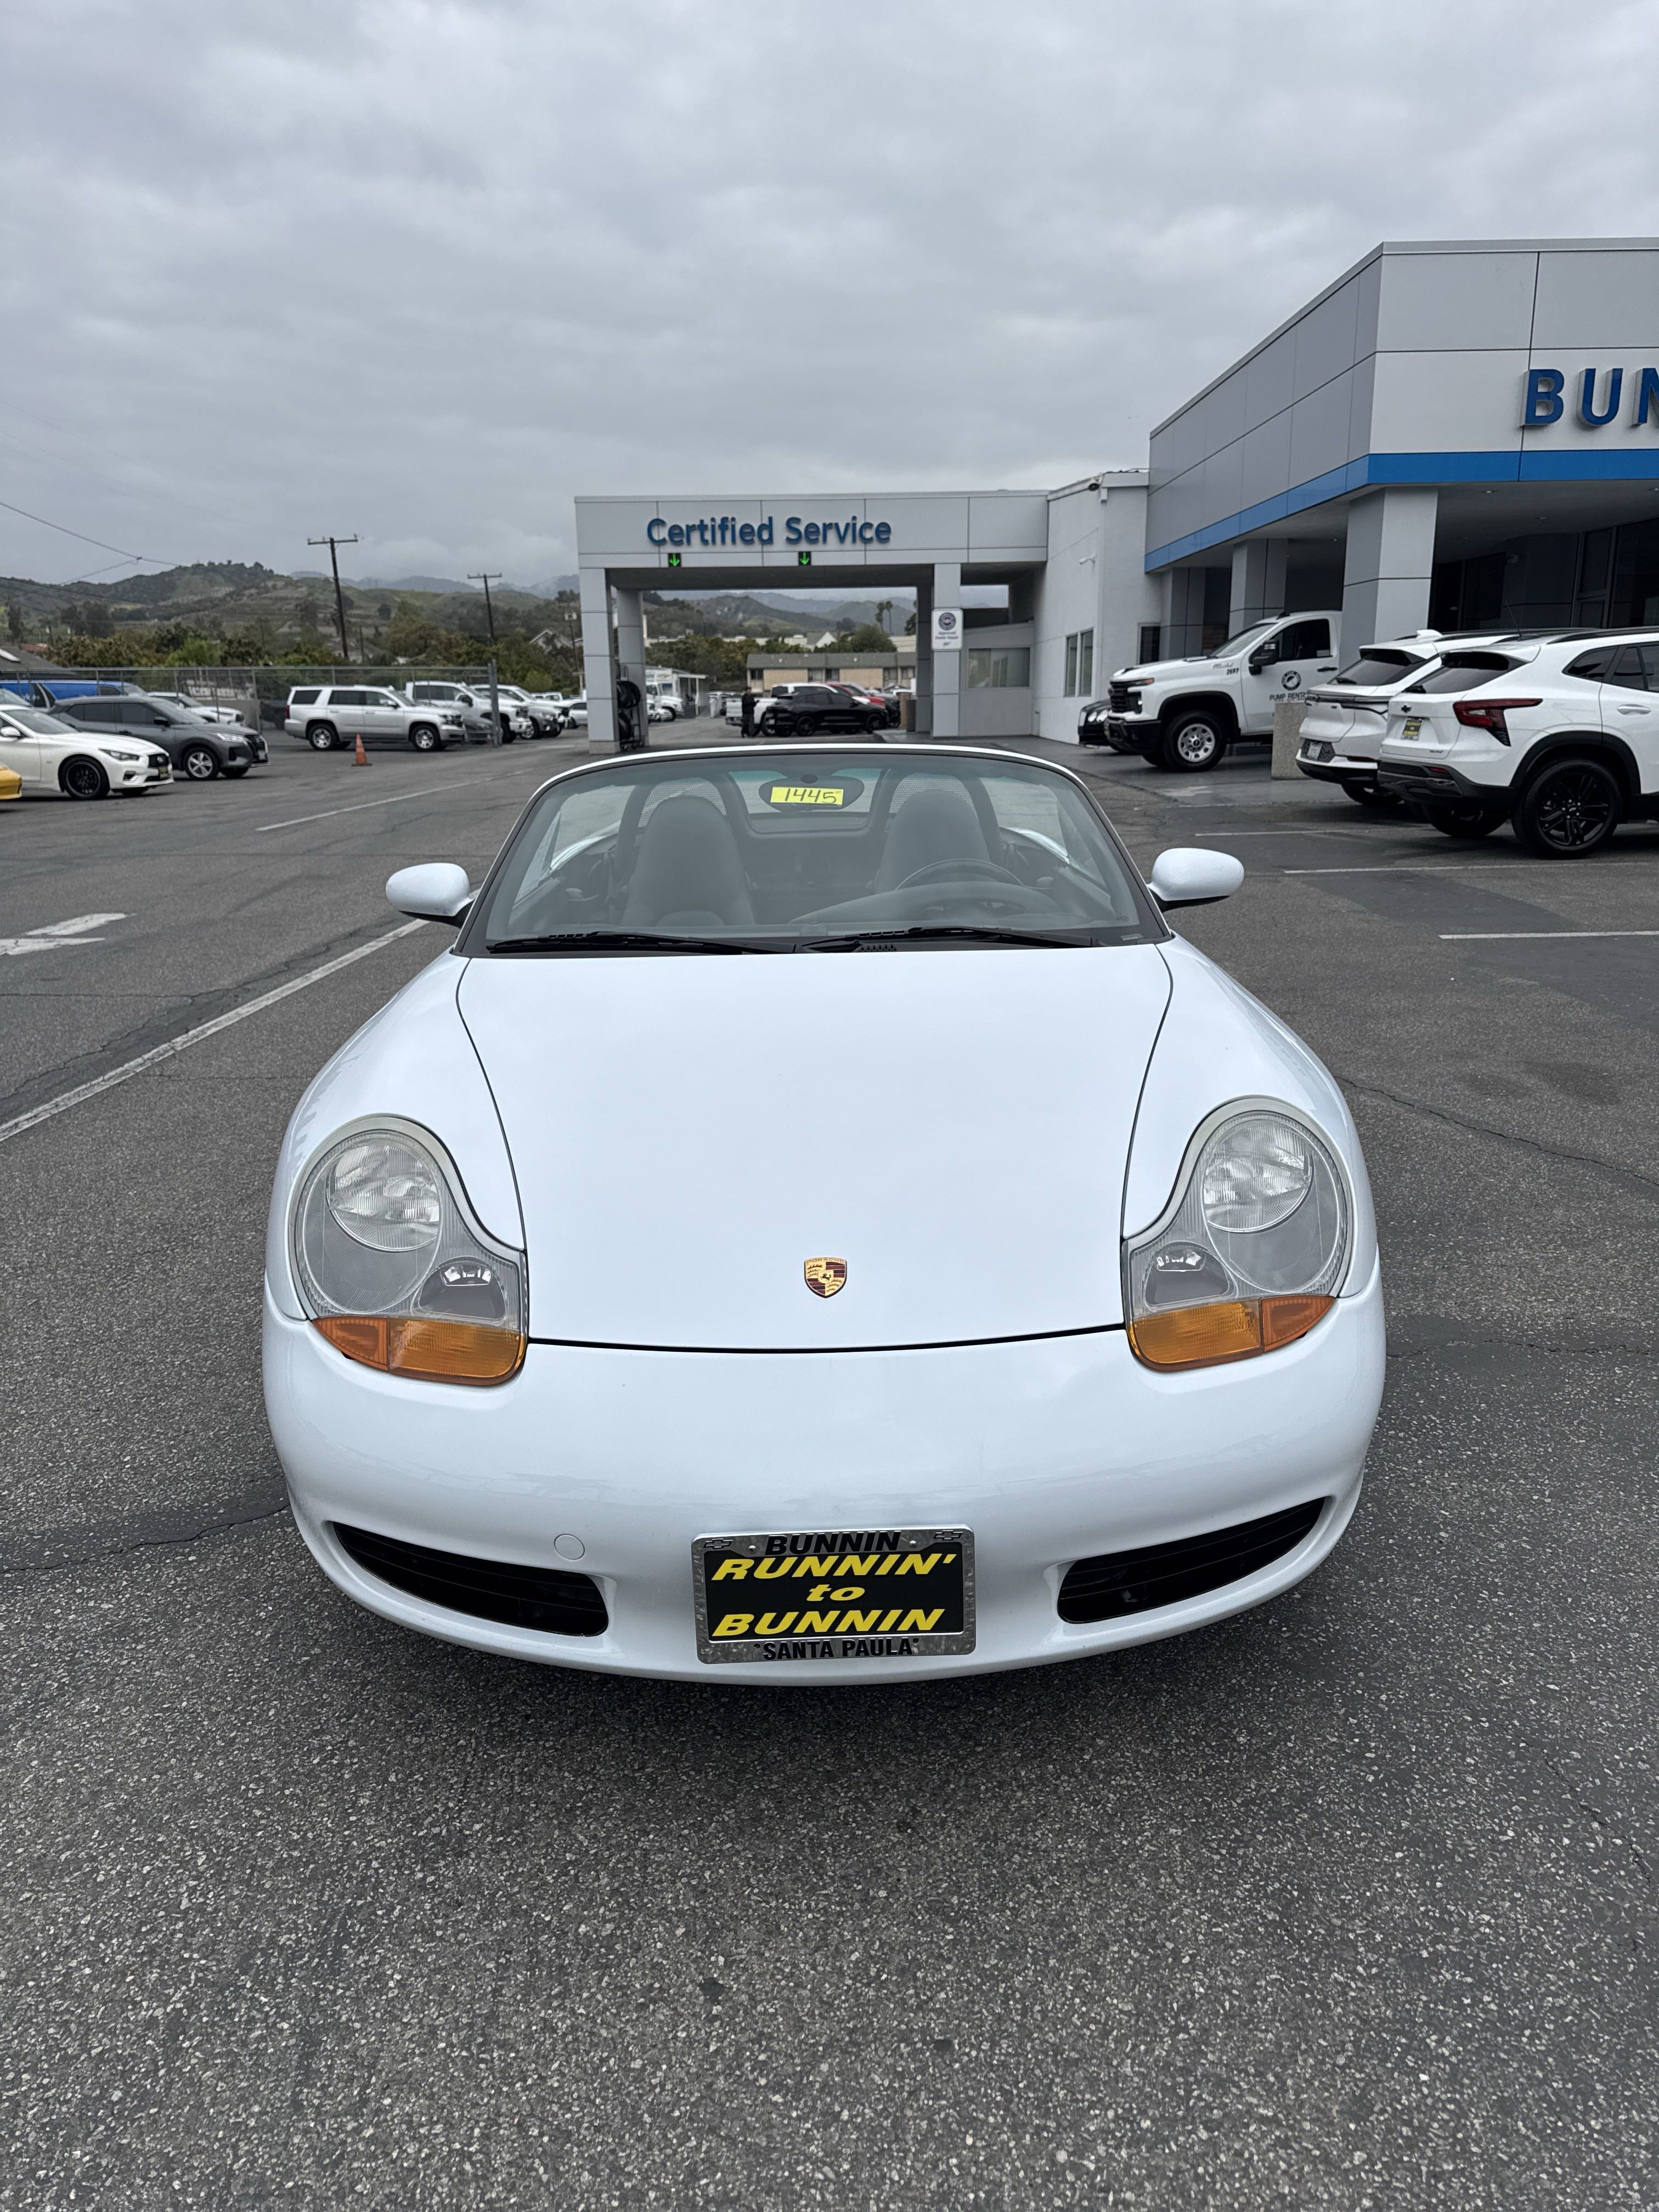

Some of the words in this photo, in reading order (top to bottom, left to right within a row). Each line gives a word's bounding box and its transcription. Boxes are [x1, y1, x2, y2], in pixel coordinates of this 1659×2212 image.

[647, 516, 774, 545] Certified
[786, 516, 892, 544] Service
[785, 788, 837, 804] 1445
[765, 1530, 901, 1555] BUNNIN
[711, 1553, 957, 1581] RUNNIN'
[806, 1584, 865, 1602] to
[712, 1609, 945, 1637] BUNNIN
[763, 1639, 834, 1661] SANTA
[842, 1637, 913, 1657] PAULA
